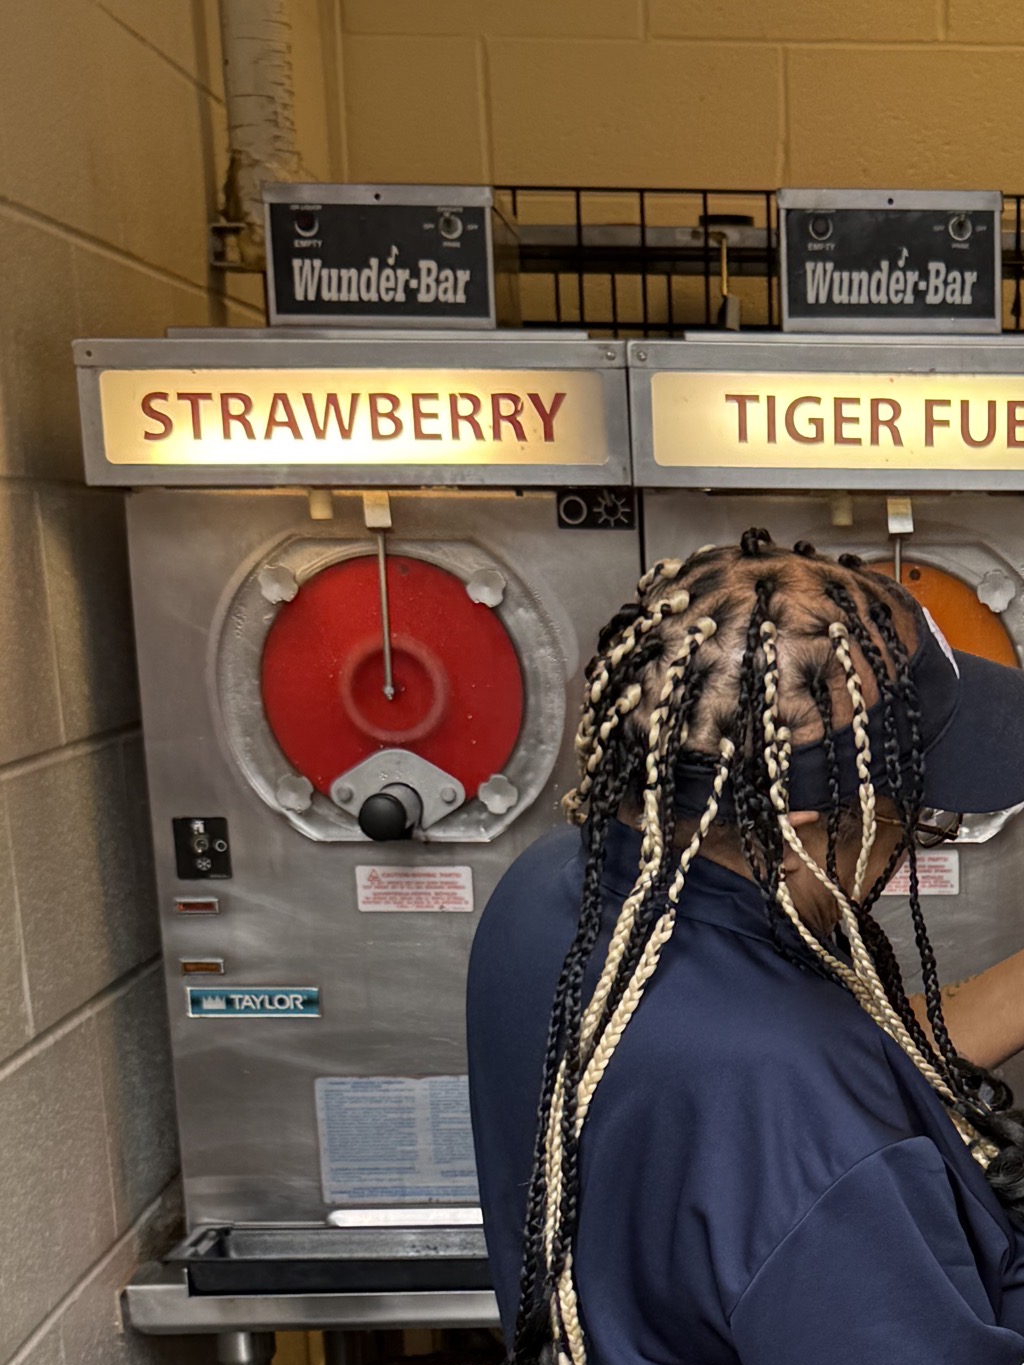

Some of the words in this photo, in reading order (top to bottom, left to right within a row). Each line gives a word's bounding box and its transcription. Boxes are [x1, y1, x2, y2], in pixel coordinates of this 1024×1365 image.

[292, 256, 470, 303] Wunder-Bar
[805, 260, 977, 304] Wunder-Bar
[141, 391, 567, 443] STRAWBERRY
[725, 394, 904, 447] TIGER
[229, 994, 305, 1010] TAYLOR
